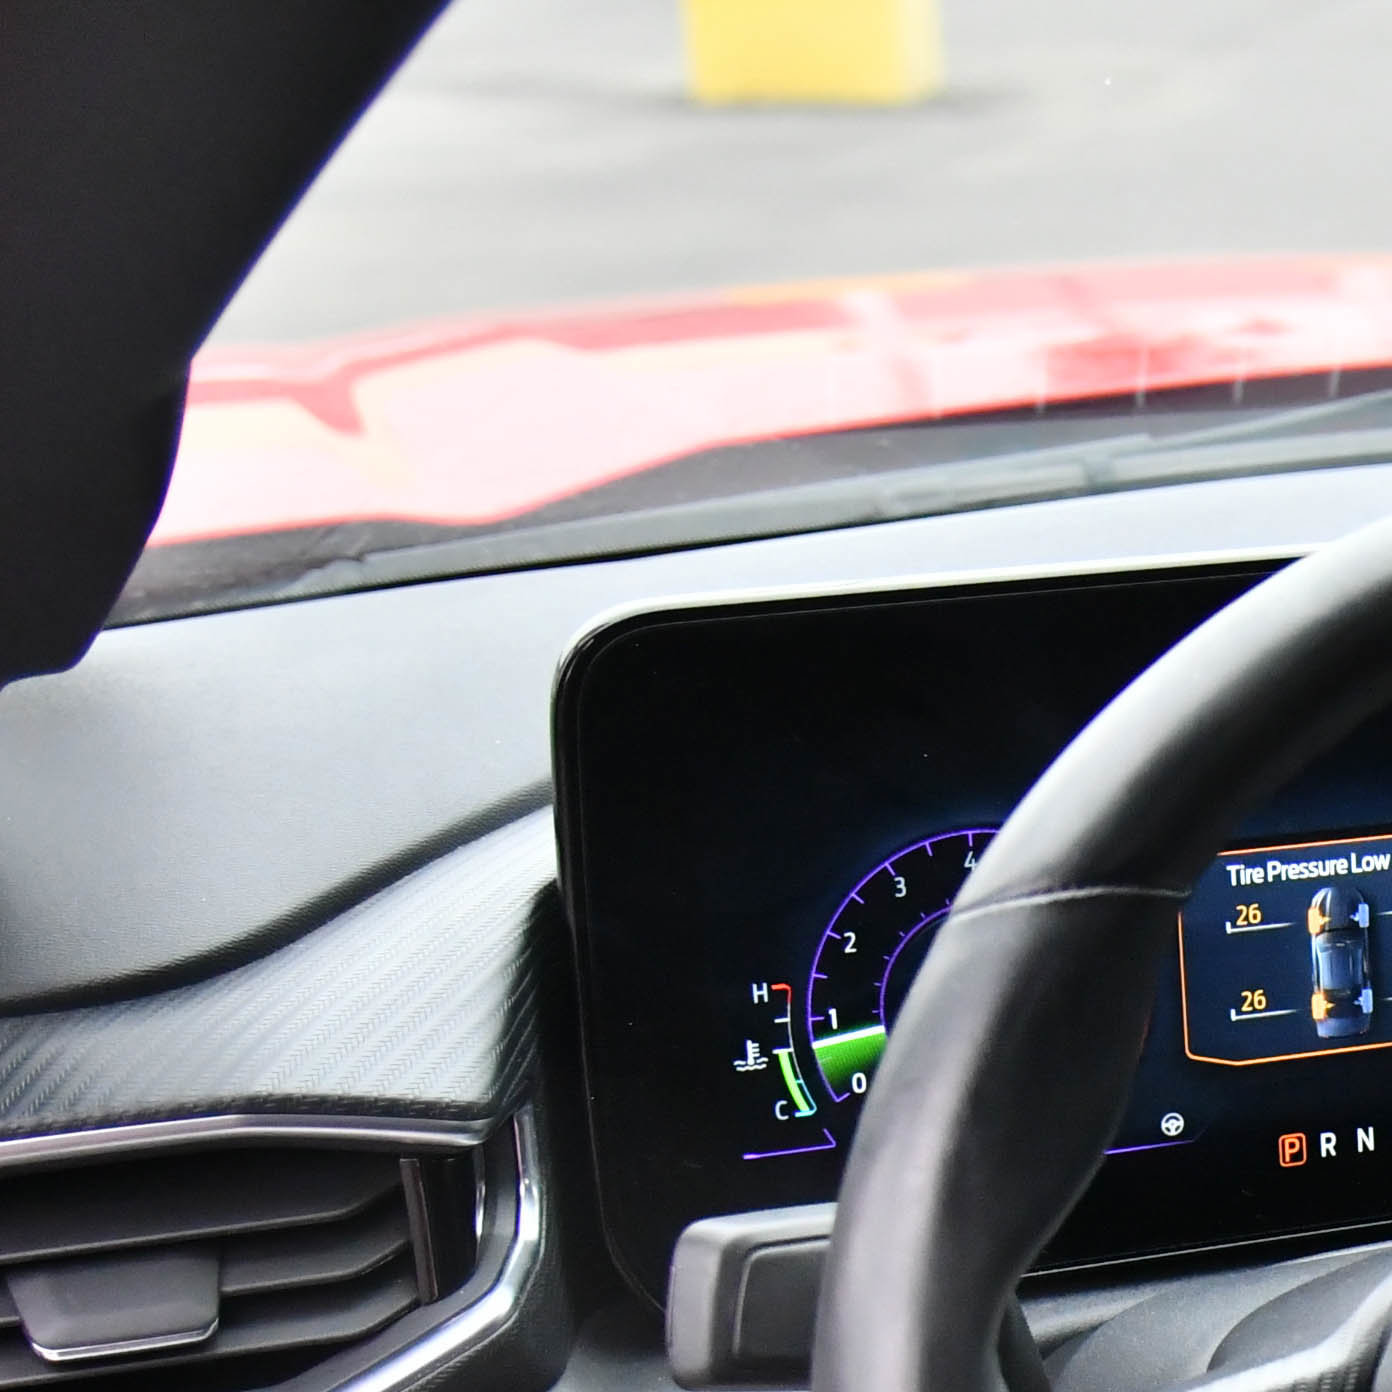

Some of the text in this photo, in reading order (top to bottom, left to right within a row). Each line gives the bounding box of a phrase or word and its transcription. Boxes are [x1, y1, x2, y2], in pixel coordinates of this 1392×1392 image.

[1226, 862, 1265, 887] Tire
[1267, 854, 1349, 882] Pressure
[1350, 850, 1391, 875] Low
[895, 877, 907, 897] 3
[1235, 904, 1262, 927] 26
[843, 932, 857, 954] 2
[752, 983, 769, 1004] H
[1240, 989, 1267, 1012] 26
[828, 1009, 838, 1030] 1
[851, 1073, 868, 1094] 0
[775, 1101, 789, 1121] C
[1284, 1138, 1300, 1162] P
[1320, 1132, 1337, 1158] R
[1357, 1126, 1375, 1152] N
